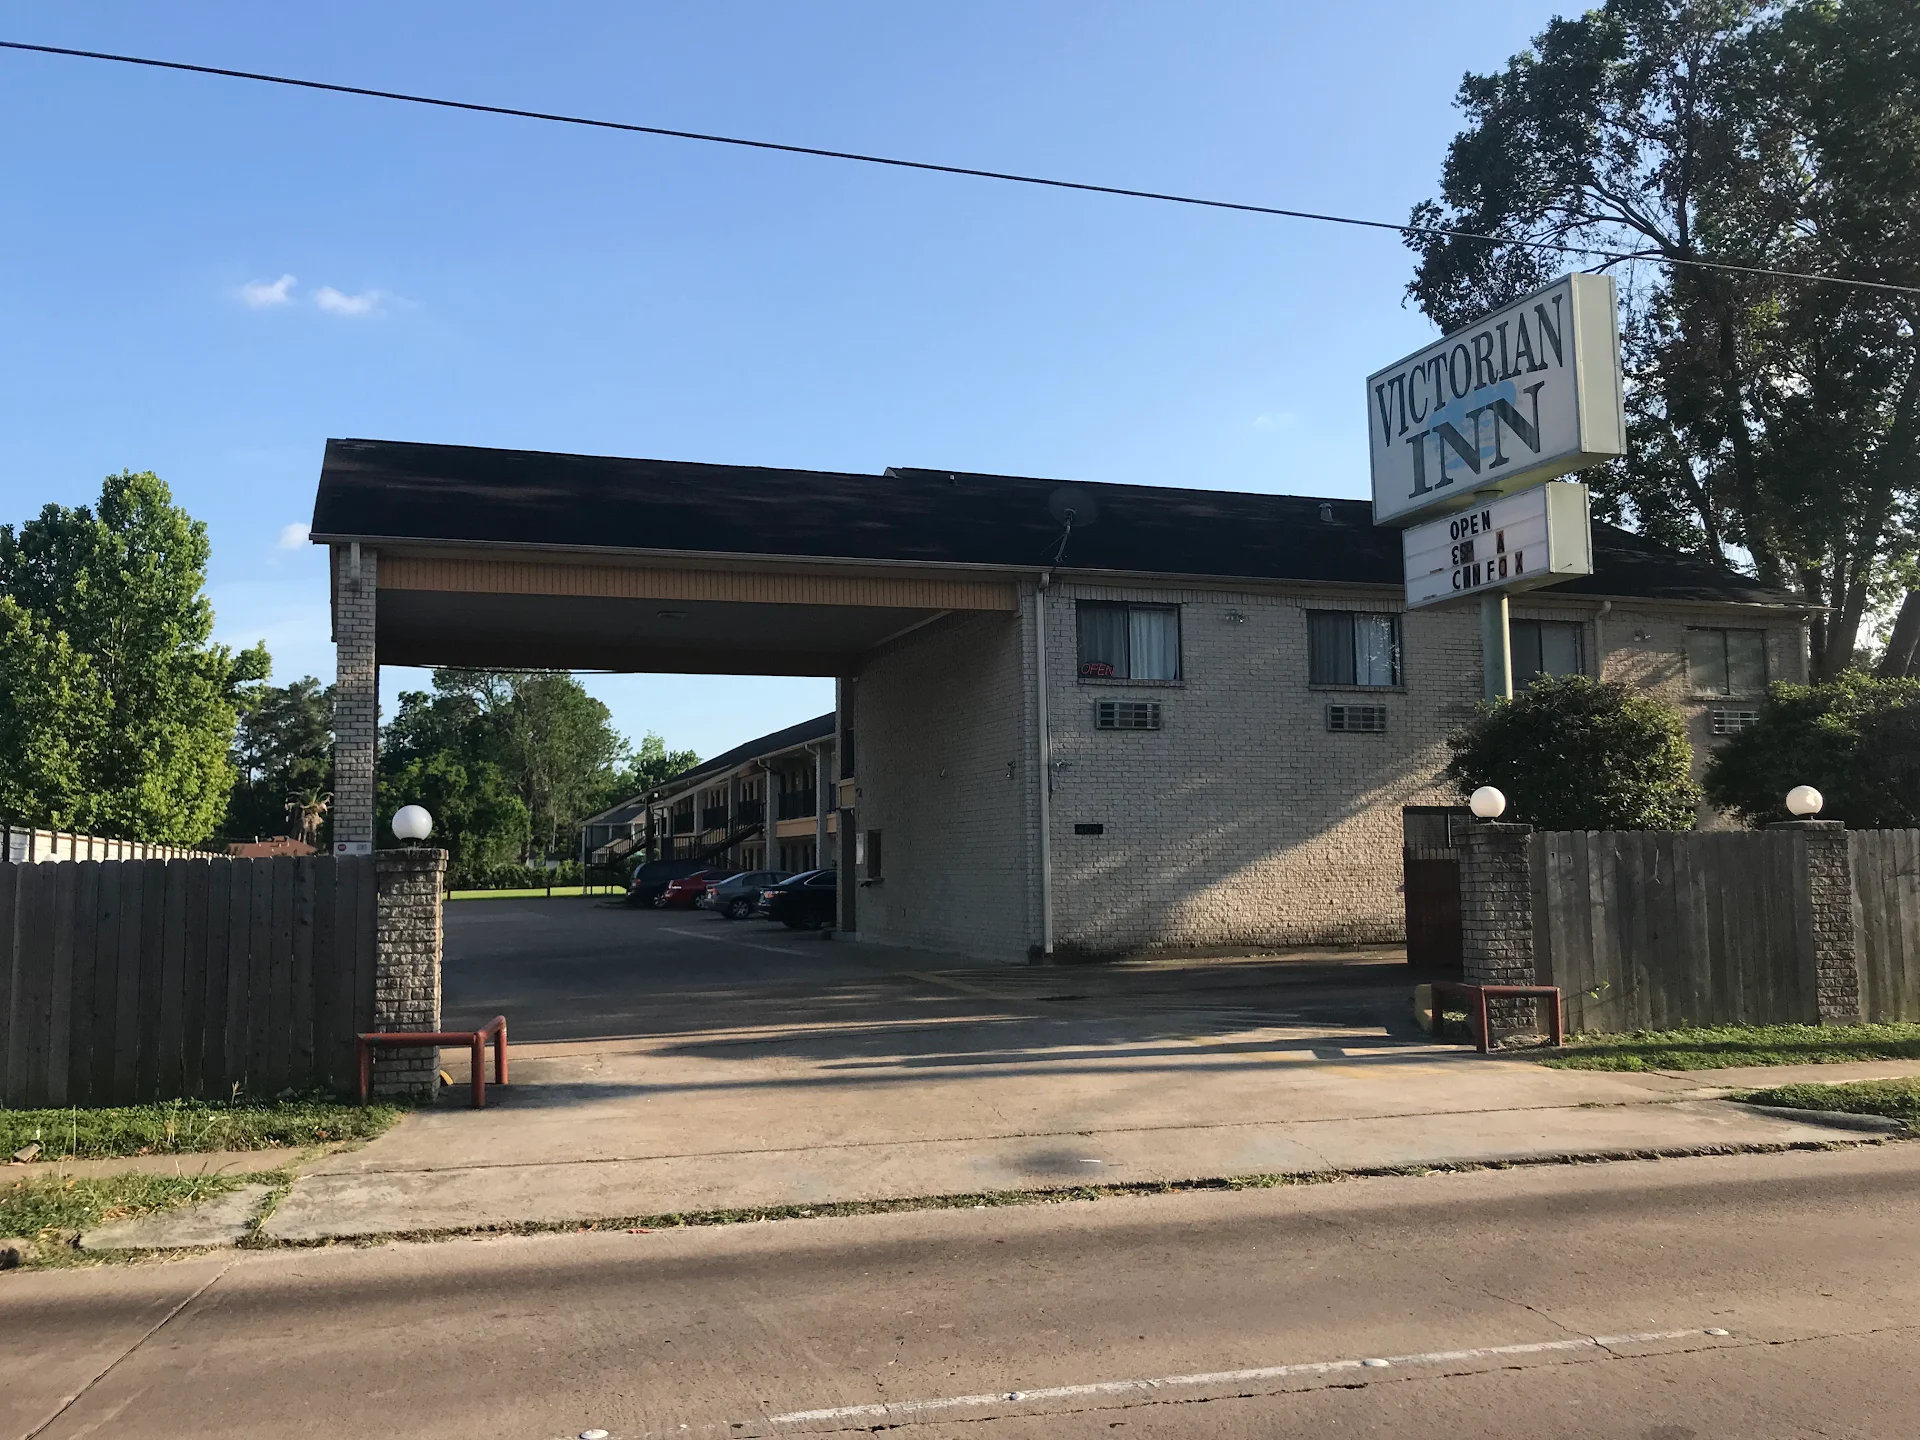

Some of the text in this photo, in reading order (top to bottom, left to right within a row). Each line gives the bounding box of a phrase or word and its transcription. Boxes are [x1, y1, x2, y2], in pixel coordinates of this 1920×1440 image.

[1375, 293, 1564, 448] VICTORIAN
[1405, 380, 1545, 499] INN
[1450, 510, 1491, 541] OPEN
[1080, 663, 1115, 677] OPEN
